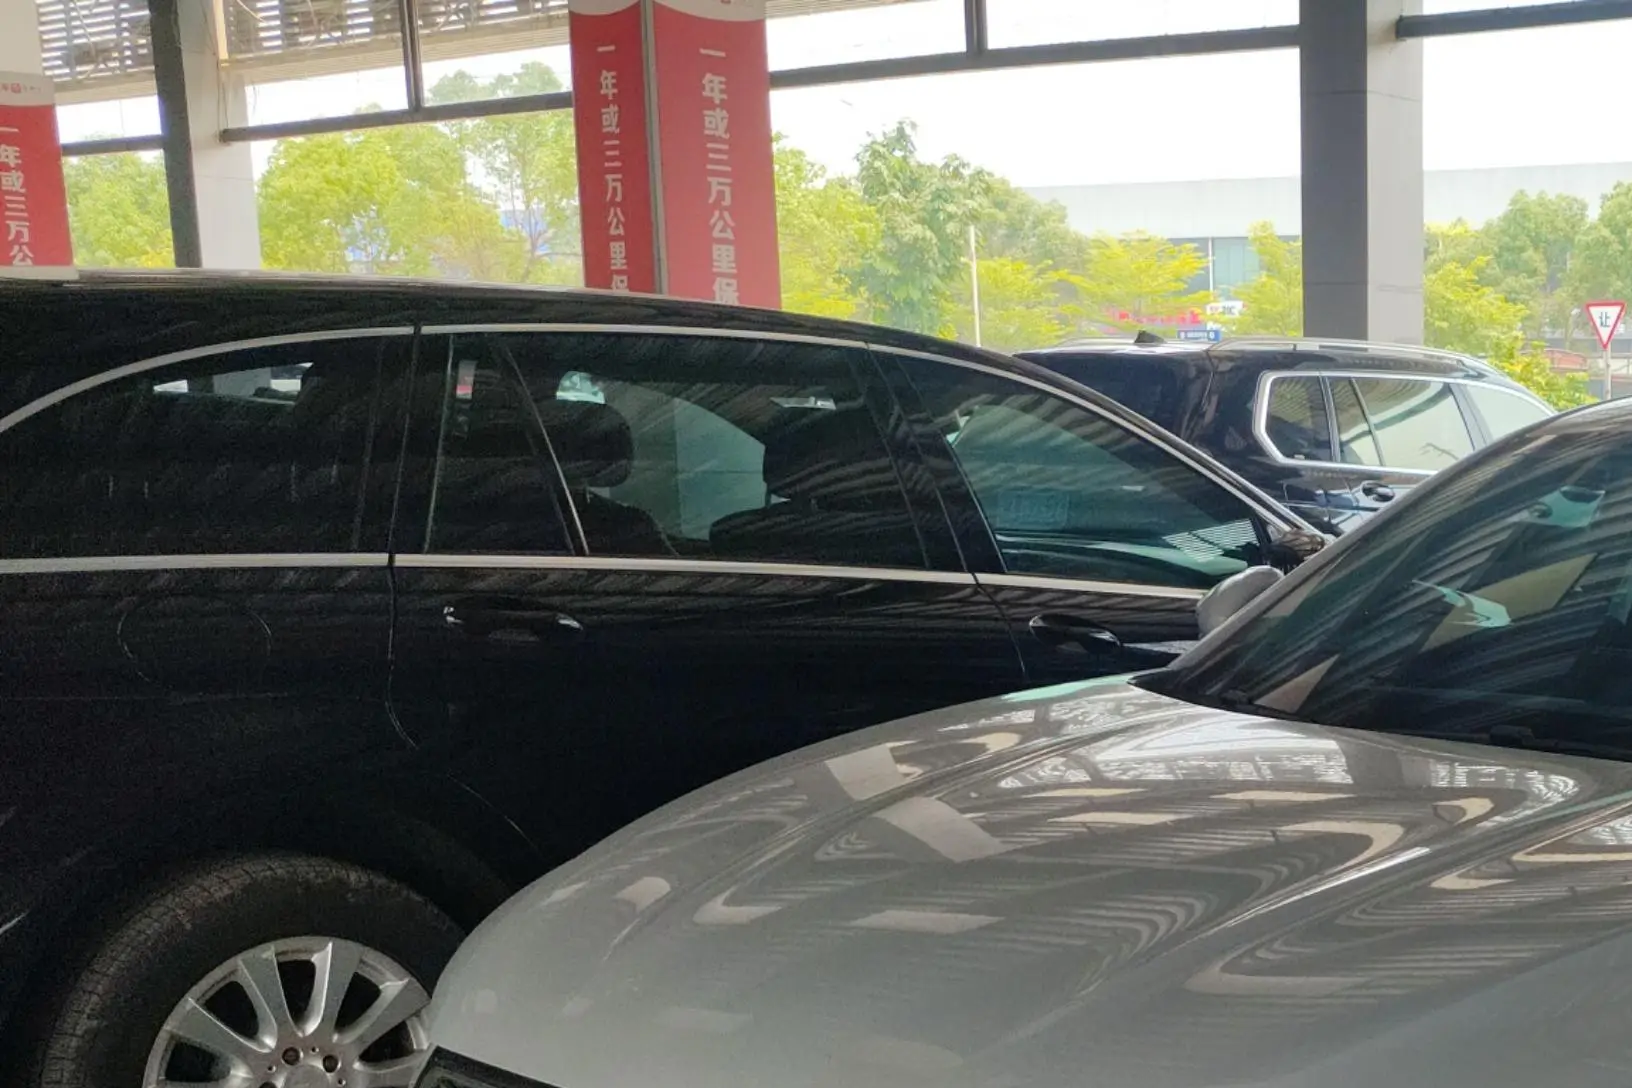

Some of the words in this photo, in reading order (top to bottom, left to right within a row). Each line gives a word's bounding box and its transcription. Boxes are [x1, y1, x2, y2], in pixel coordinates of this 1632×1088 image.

[699, 47, 739, 305] 一年或三万公里保
[1599, 311, 1611, 327] 让
